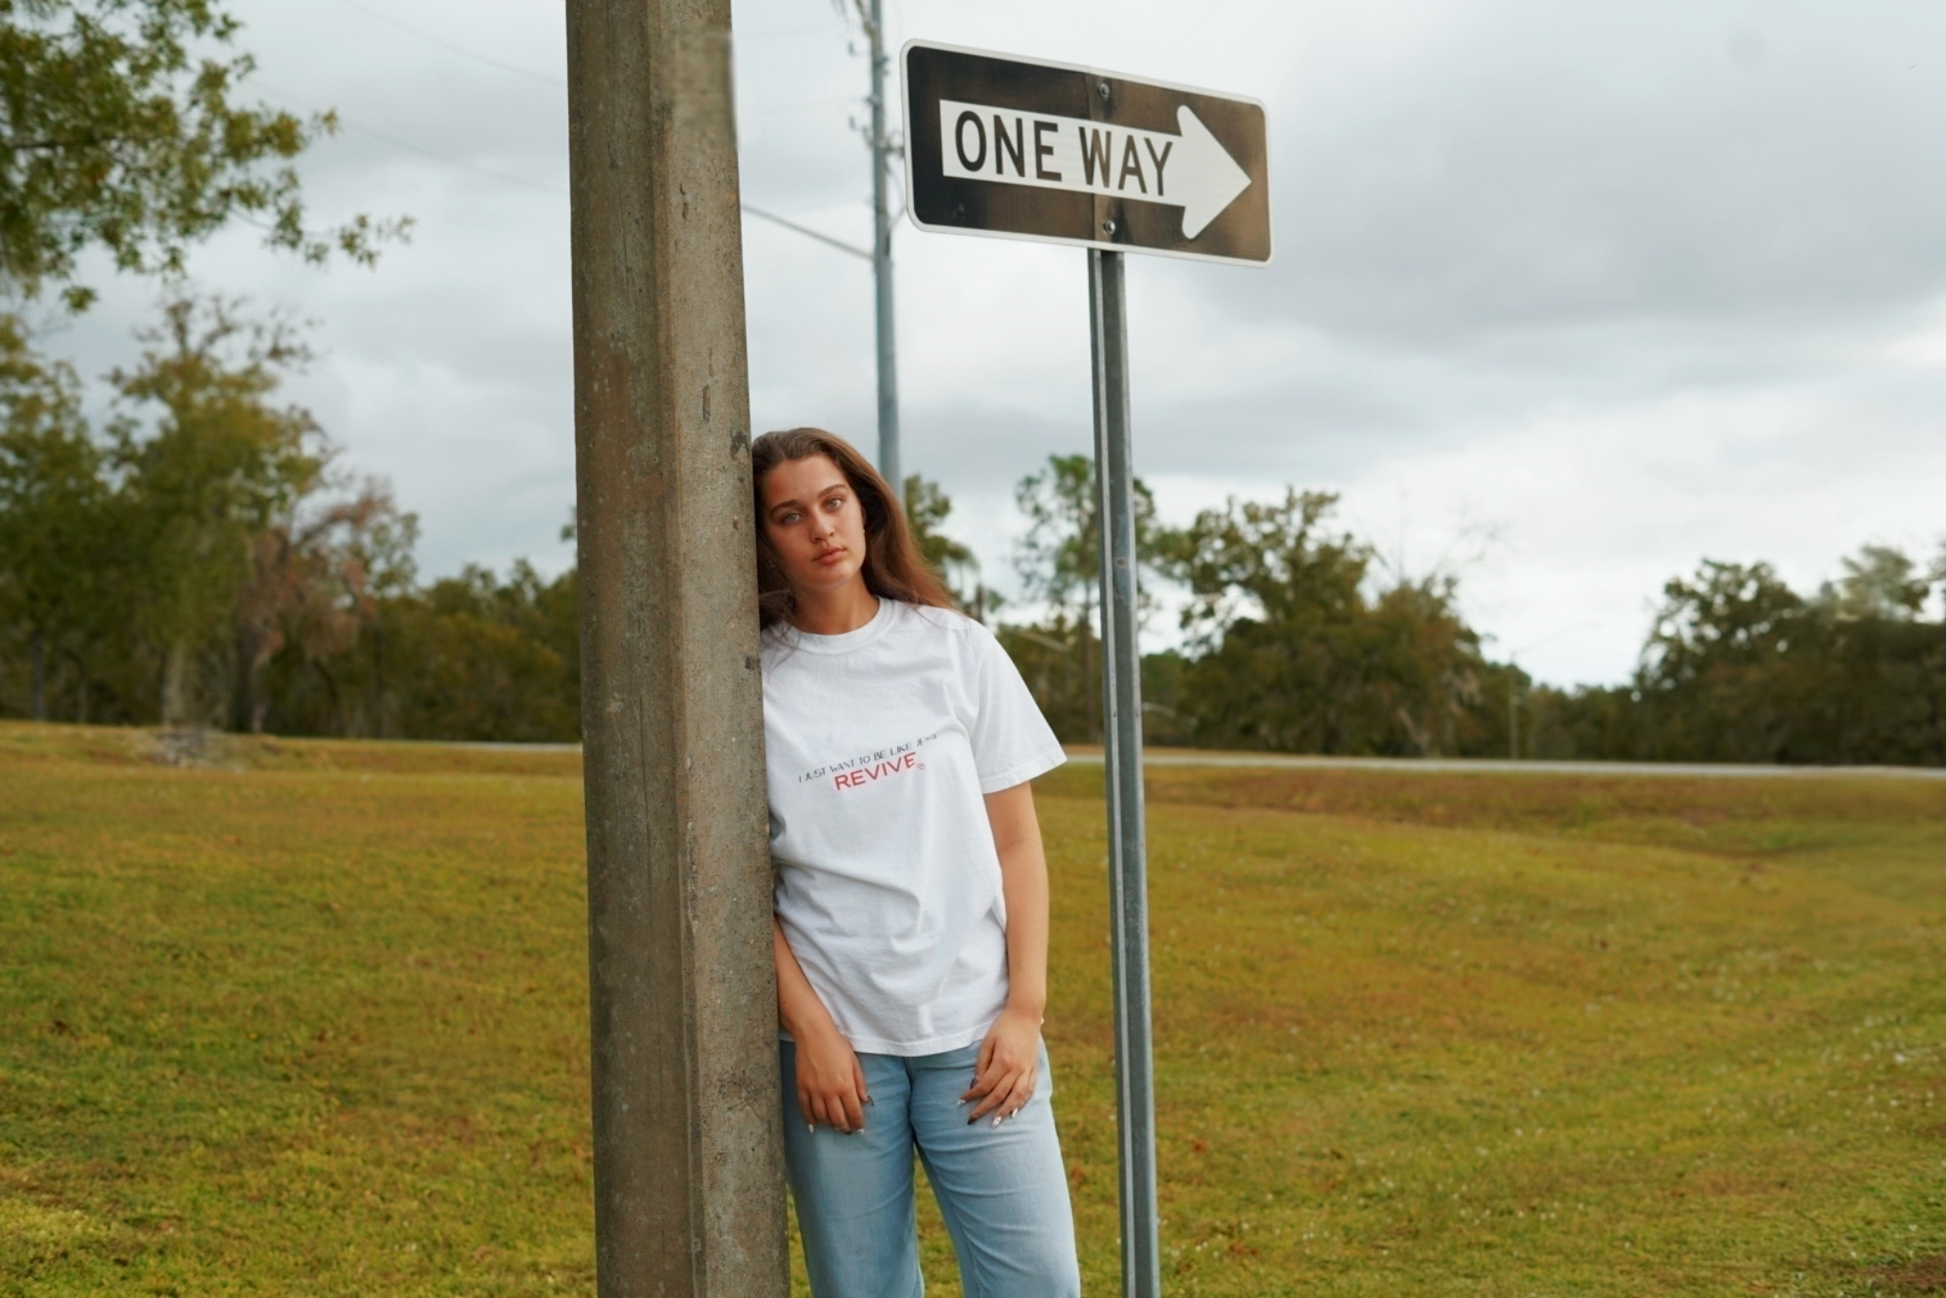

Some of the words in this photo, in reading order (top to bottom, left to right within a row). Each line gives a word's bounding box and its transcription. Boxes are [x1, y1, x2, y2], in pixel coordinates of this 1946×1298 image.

[955, 110, 1062, 182] ONE
[1078, 126, 1173, 197] WAY
[834, 752, 916, 790] REVIVE
[859, 755, 870, 766] TO
[873, 750, 887, 761] BE
[889, 742, 912, 756] LIKE
